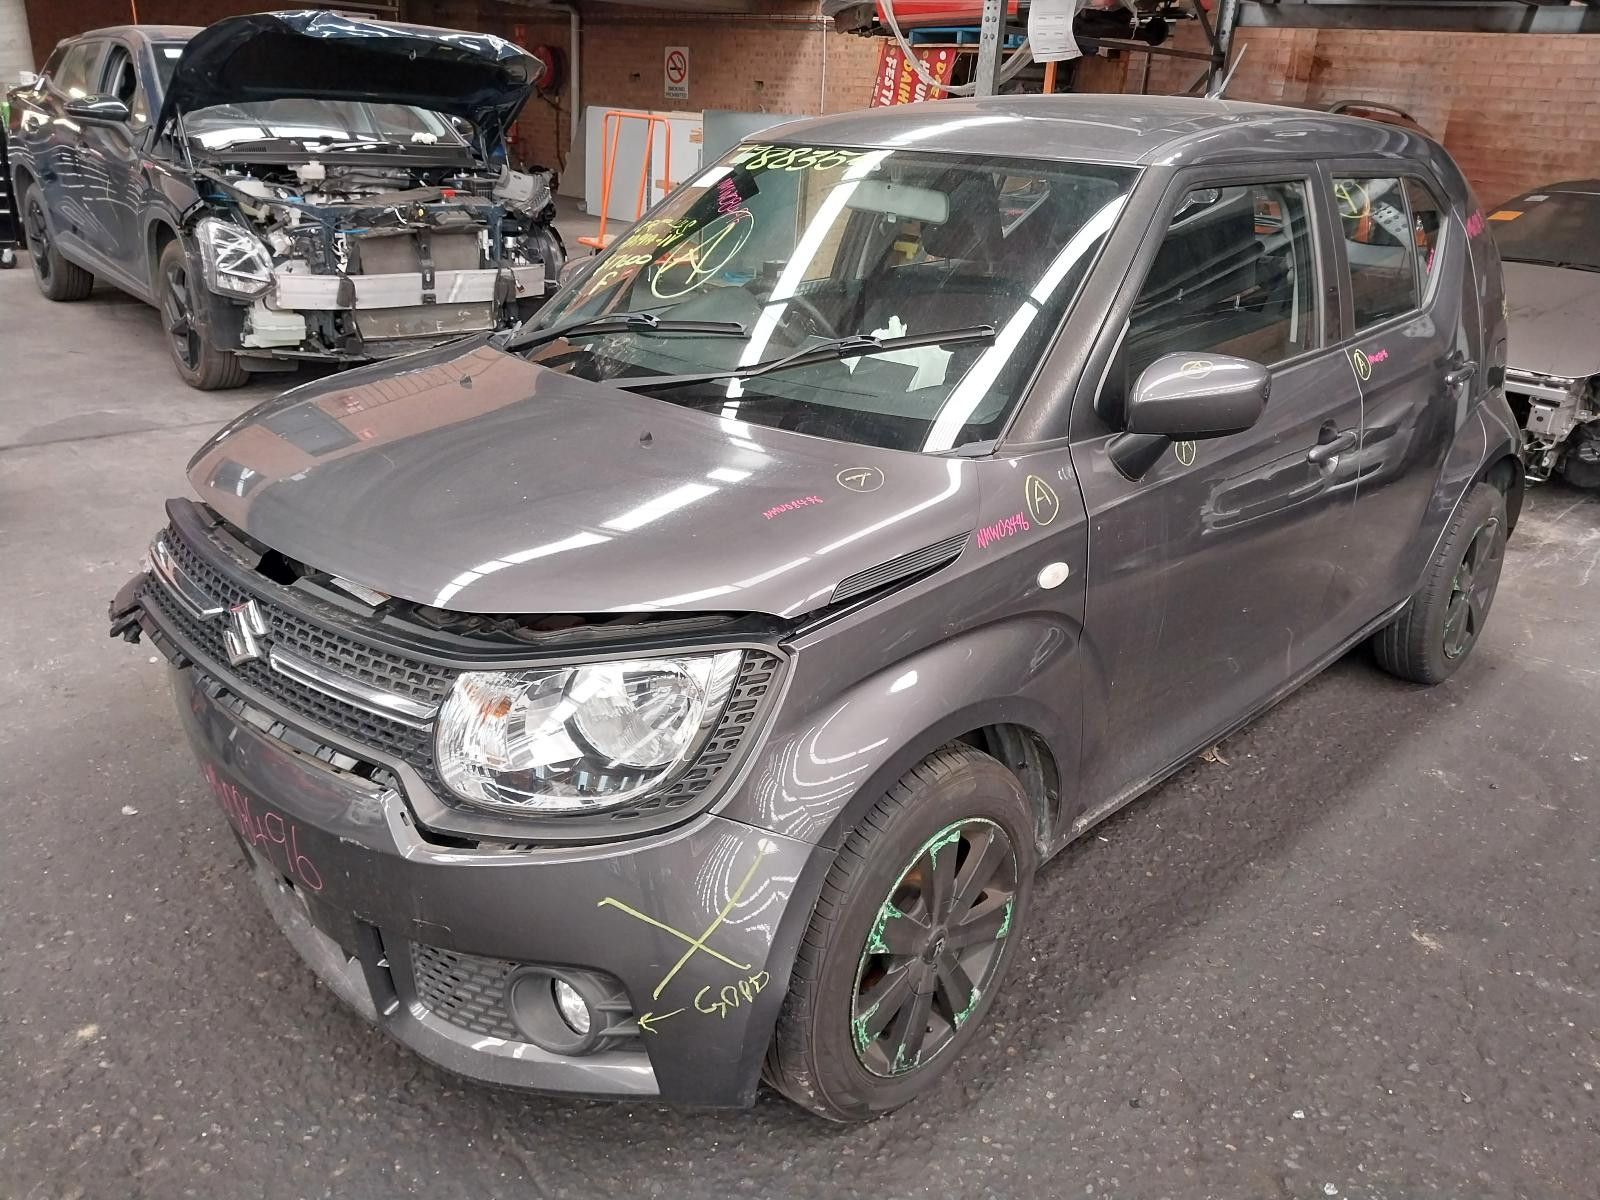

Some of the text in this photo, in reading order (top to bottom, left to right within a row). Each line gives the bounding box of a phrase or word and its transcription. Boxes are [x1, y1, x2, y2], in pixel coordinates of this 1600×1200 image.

[879, 56, 897, 108] FESTI
[897, 58, 912, 105] DAIH
[929, 62, 946, 101] DAE
